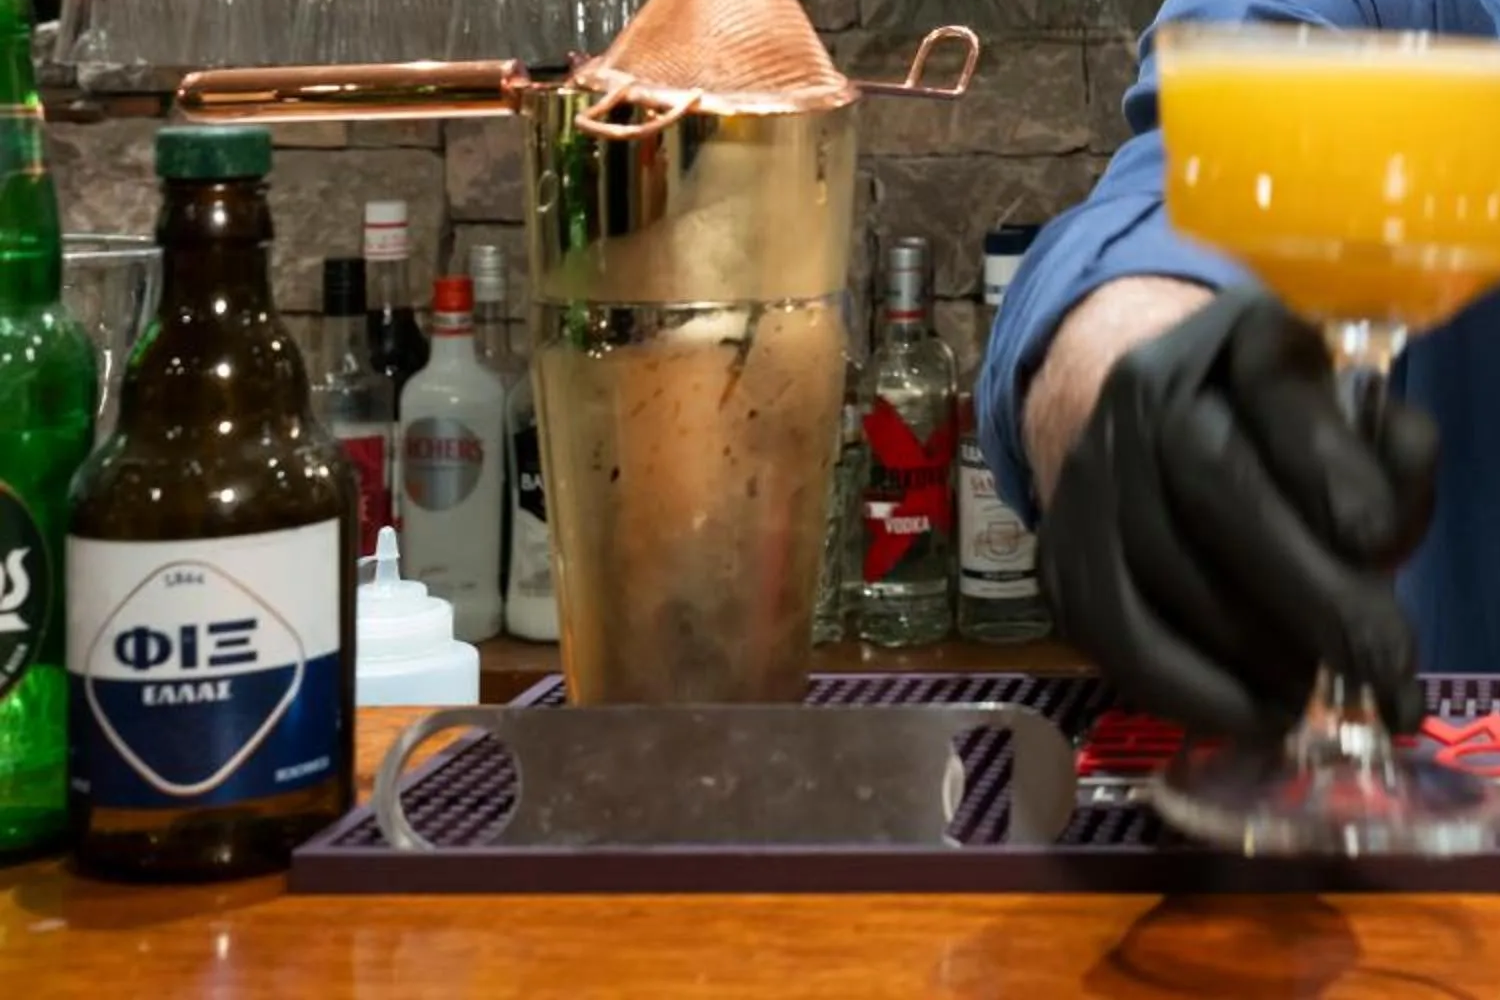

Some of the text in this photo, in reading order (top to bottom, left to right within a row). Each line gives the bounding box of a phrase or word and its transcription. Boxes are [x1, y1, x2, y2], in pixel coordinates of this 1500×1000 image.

[884, 515, 932, 535] VODKA
[113, 617, 260, 671] ΦΙΞ
[142, 677, 233, 707] ΕΛΛΑΣ
